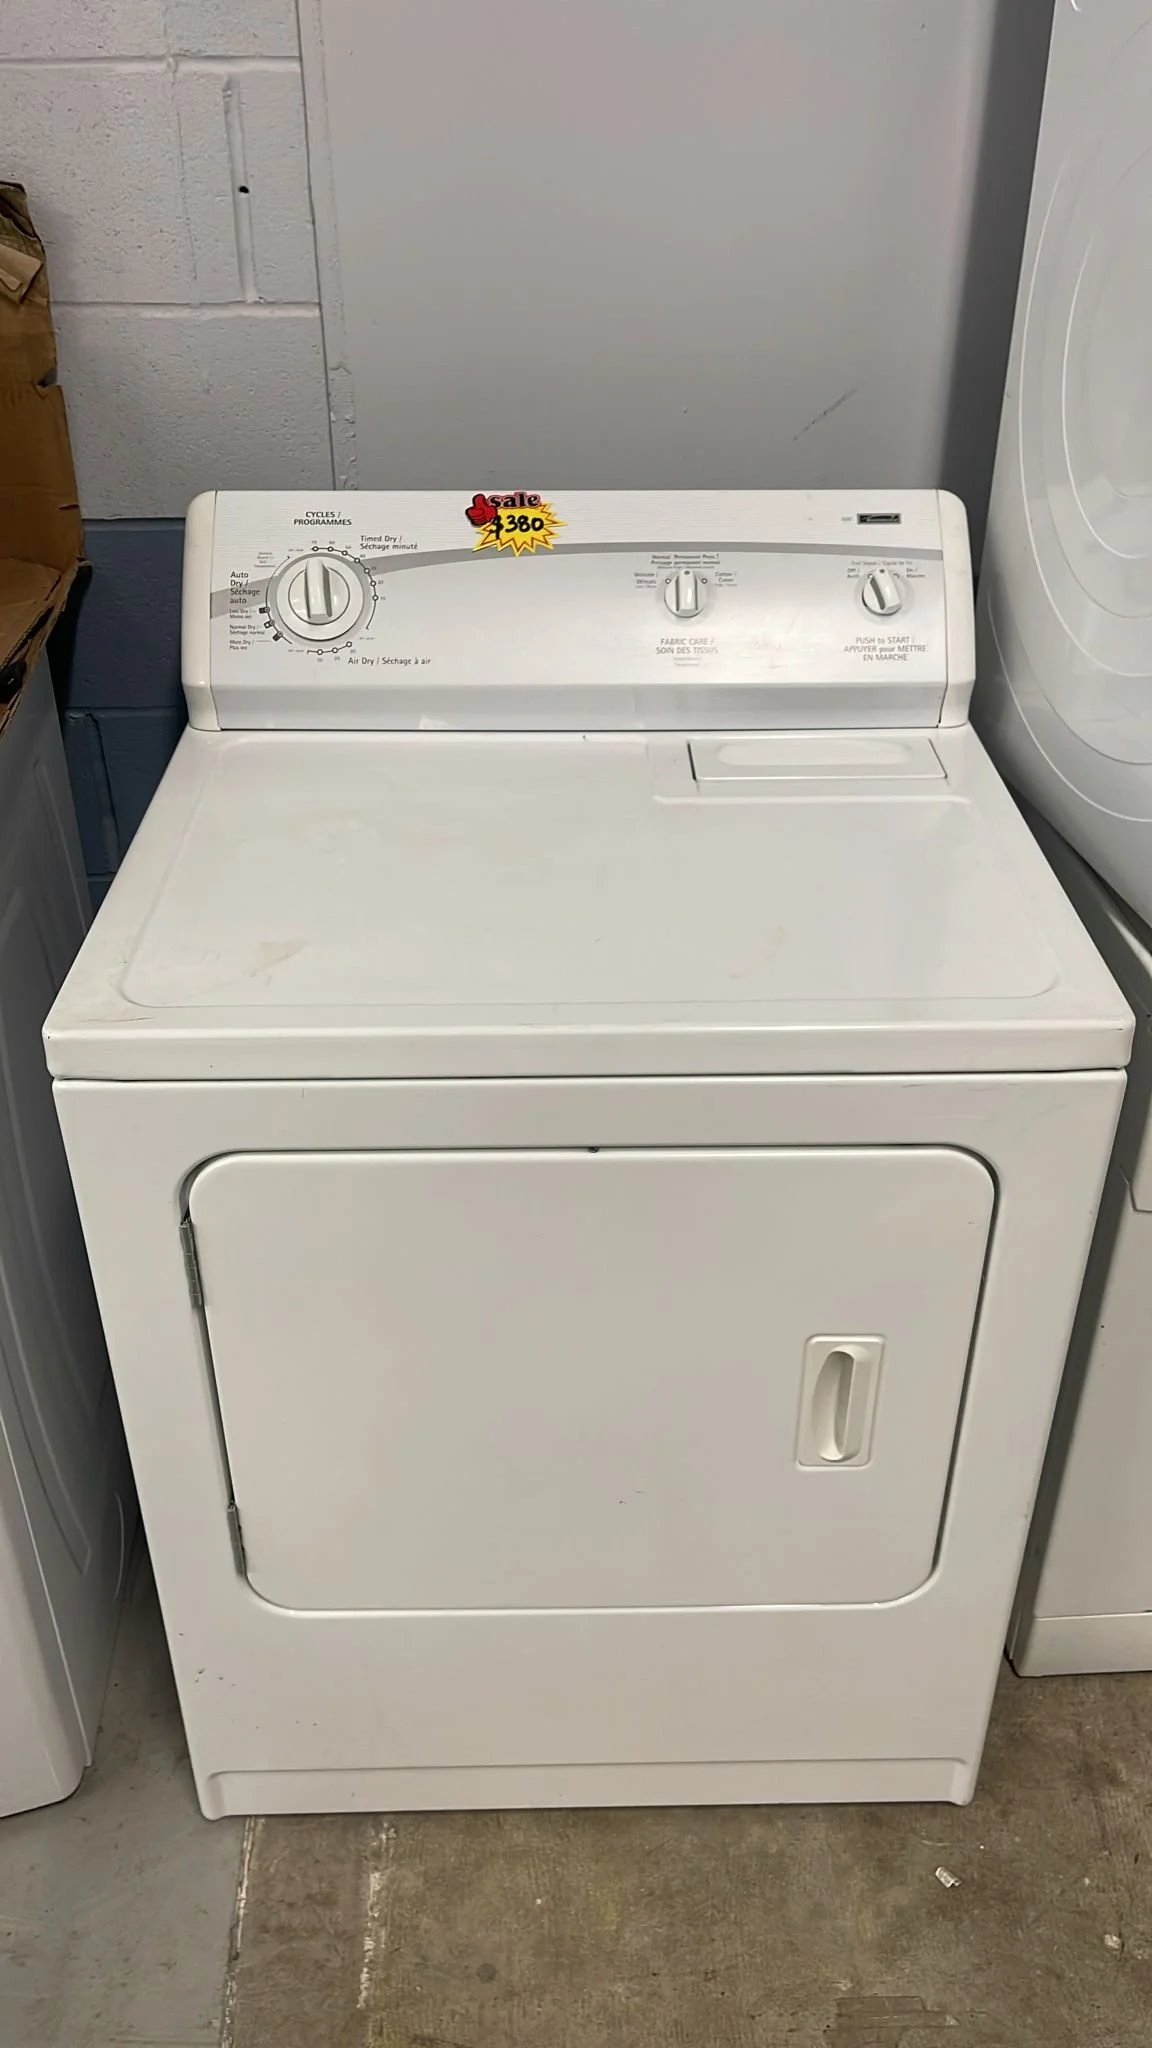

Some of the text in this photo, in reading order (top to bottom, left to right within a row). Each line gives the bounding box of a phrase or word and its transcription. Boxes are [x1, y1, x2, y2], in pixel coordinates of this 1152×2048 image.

[488, 492, 541, 508] sale
[293, 518, 352, 526] PROGRAMMES
[490, 515, 544, 539] $380
[385, 535, 398, 544] Dry
[360, 542, 390, 551] Séchage
[230, 580, 243, 588] Dry
[230, 588, 260, 596] Séchage
[660, 638, 687, 646] FABRIC
[689, 638, 708, 646] CARE
[656, 646, 674, 654] SOIN
[362, 657, 374, 666] Dry
[382, 656, 412, 666] Séchage
[414, 656, 418, 664] à
